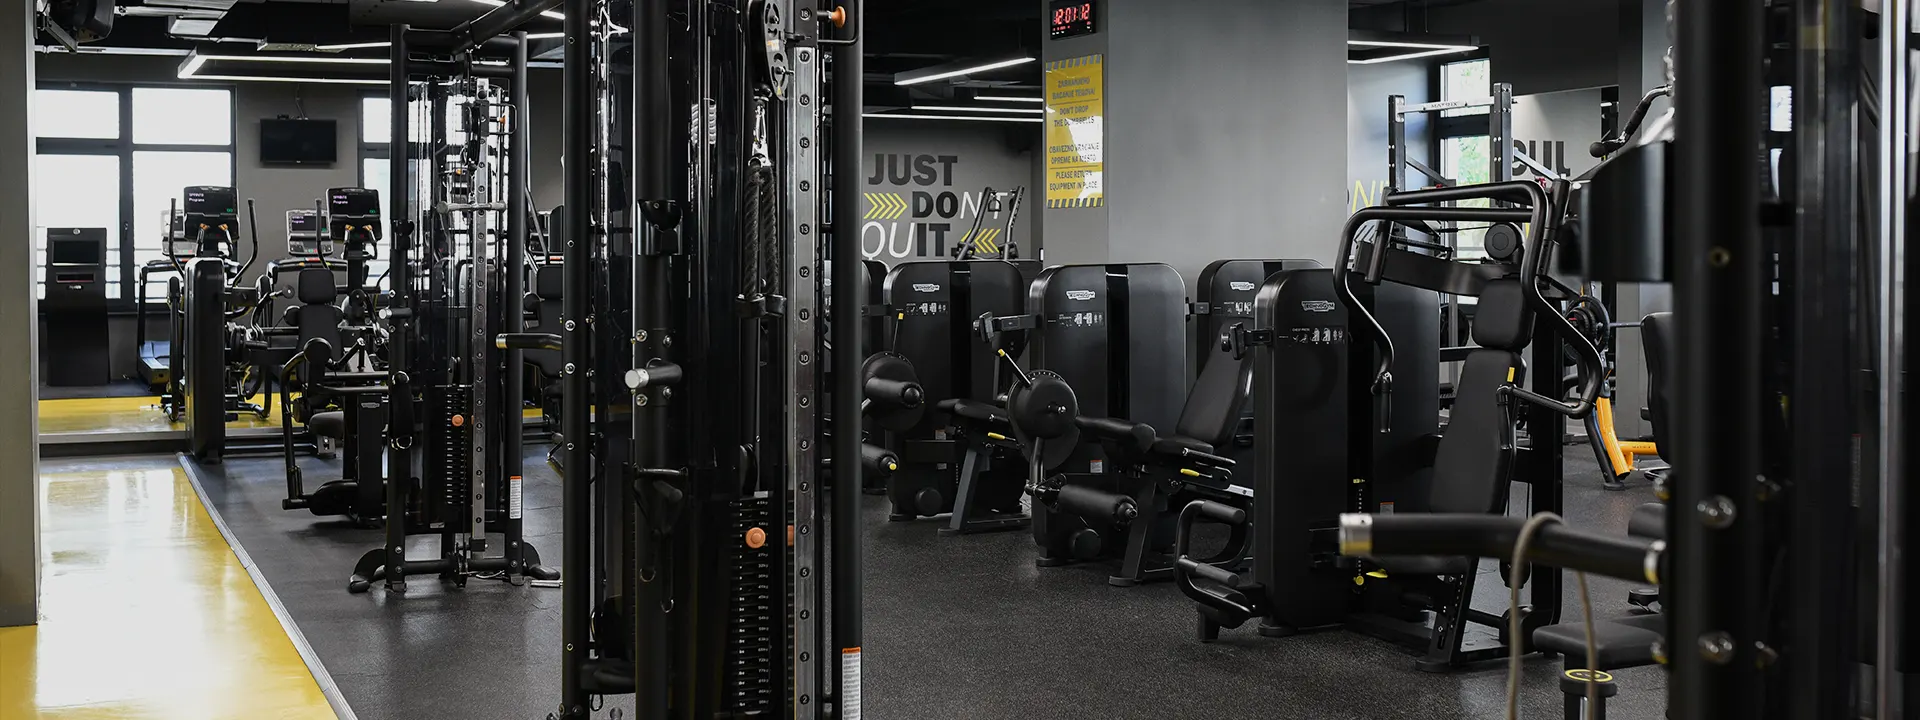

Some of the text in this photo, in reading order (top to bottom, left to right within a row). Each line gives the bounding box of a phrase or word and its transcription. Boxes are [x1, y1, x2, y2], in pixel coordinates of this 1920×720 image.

[1054, 118, 1063, 127] THE
[868, 153, 958, 187] JUST
[1055, 171, 1073, 179] PLEASE
[1049, 182, 1076, 191] EQUIPMENT
[912, 190, 1008, 220] DONT
